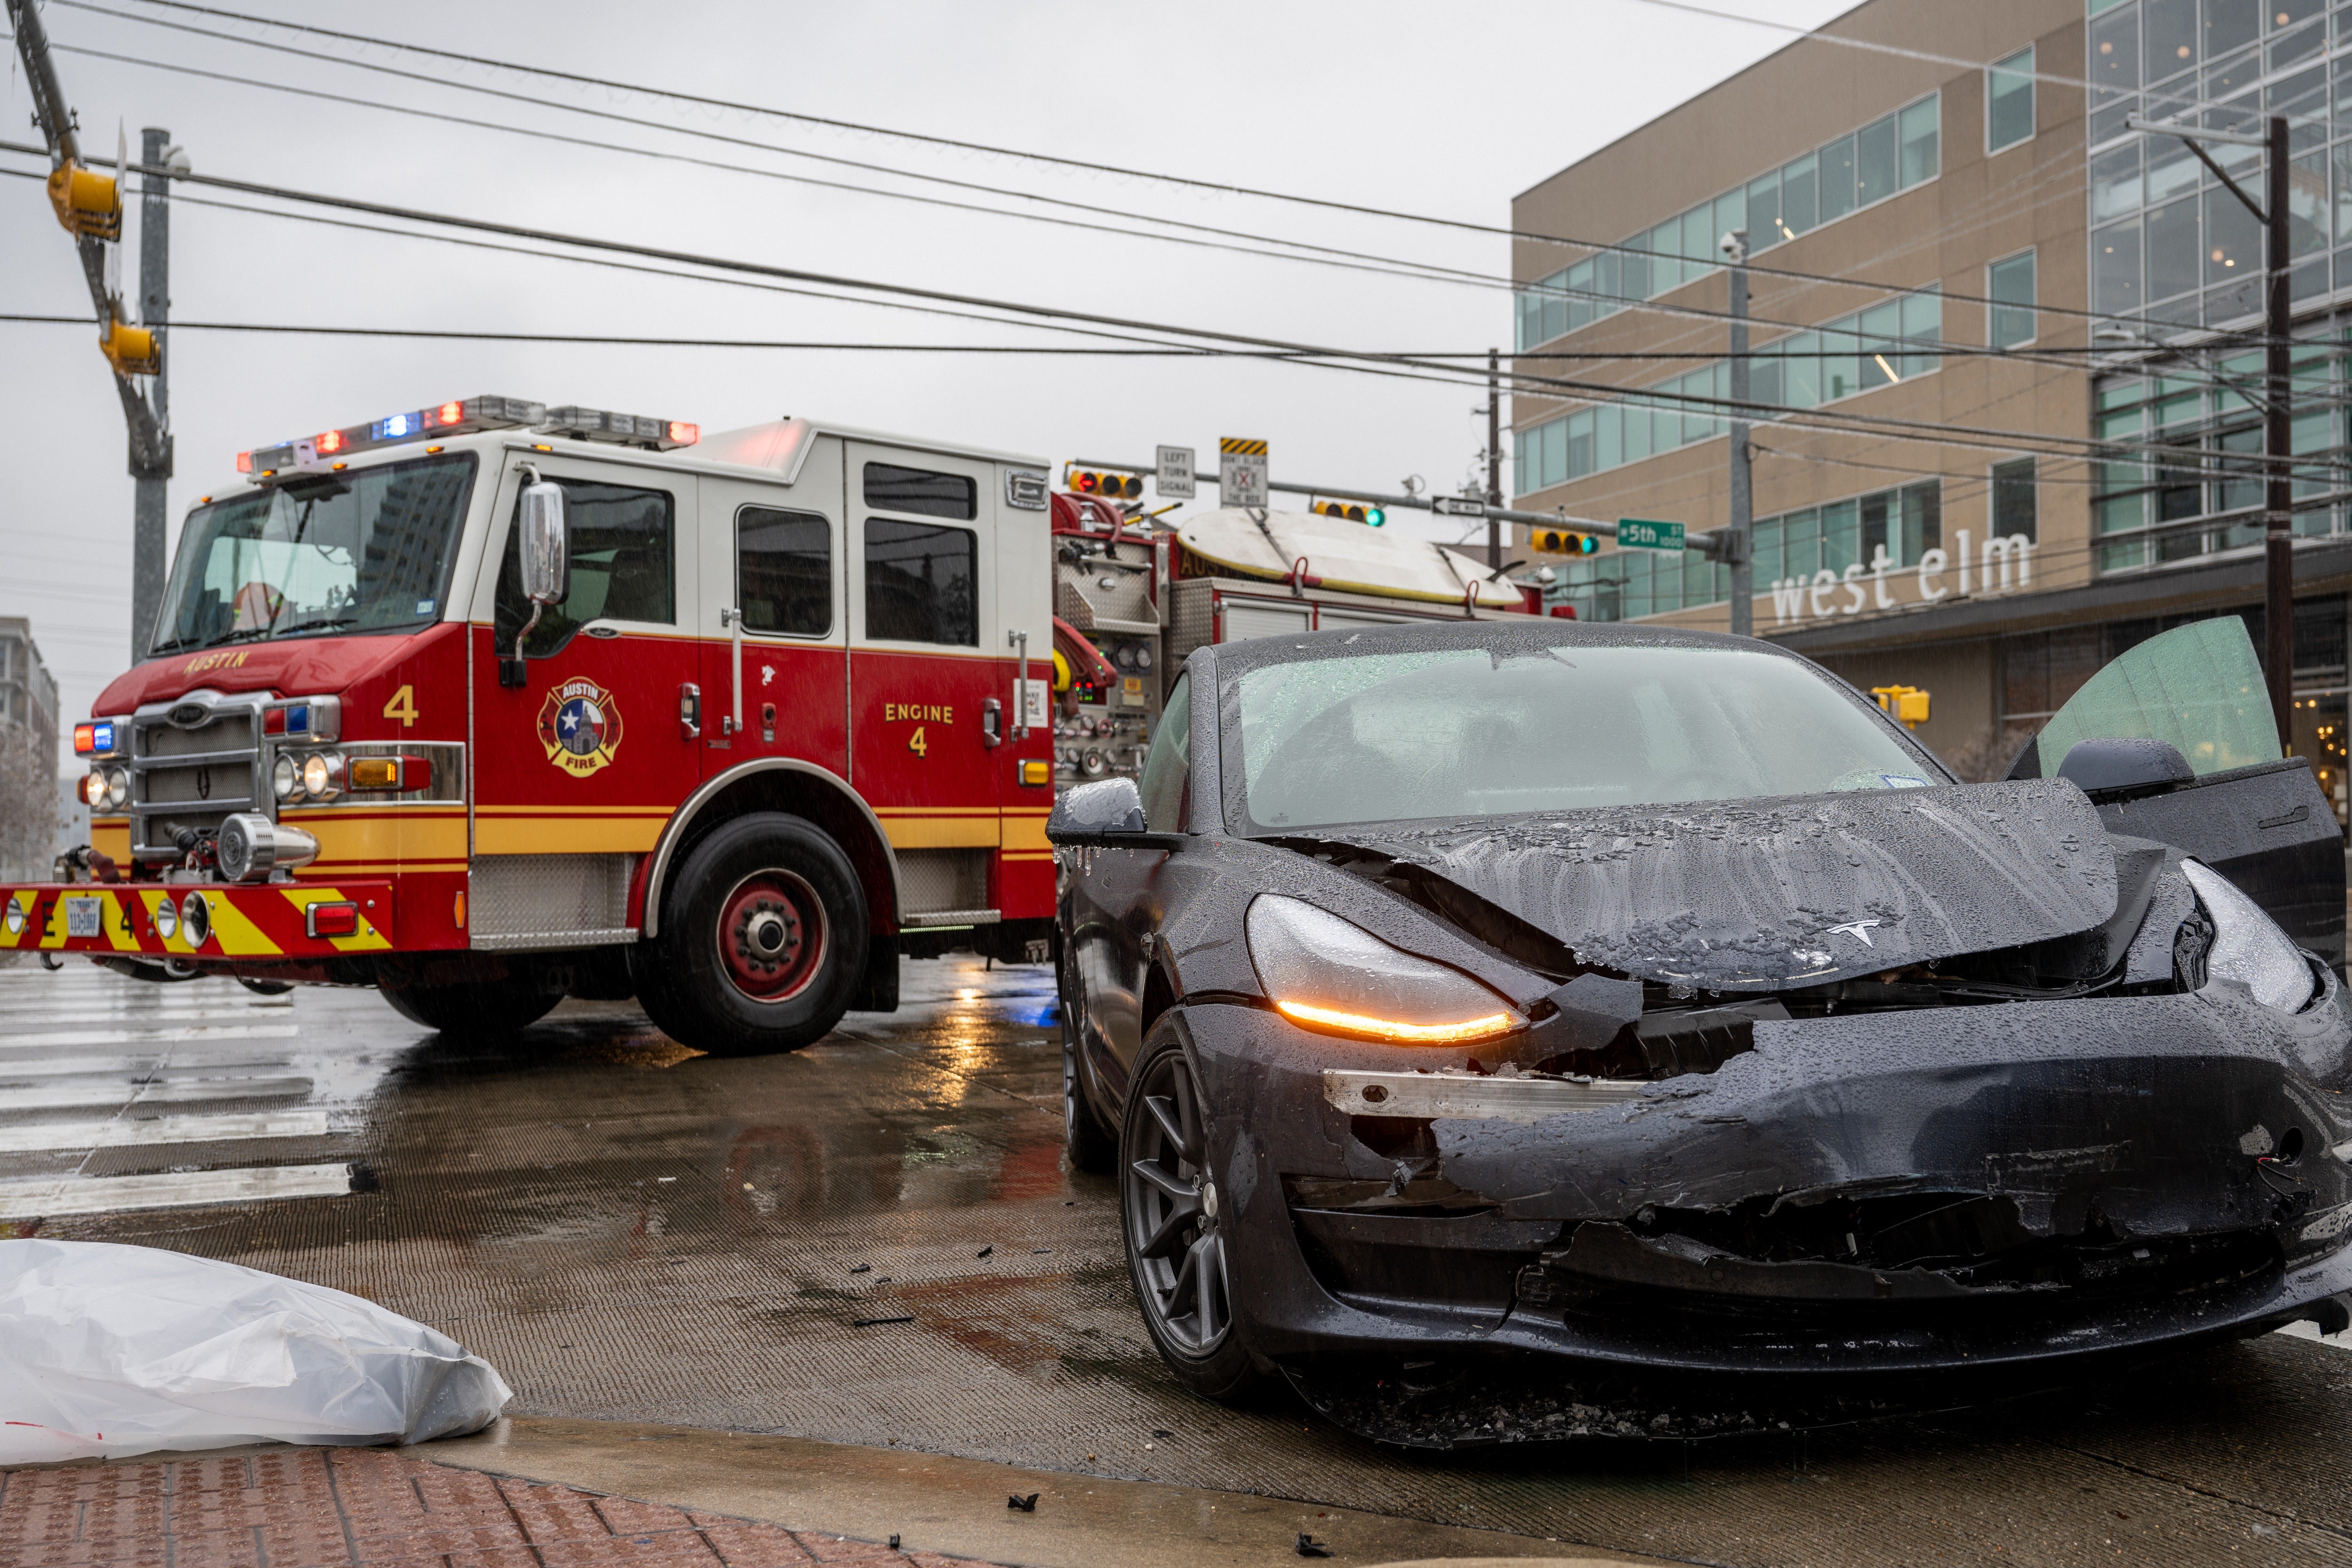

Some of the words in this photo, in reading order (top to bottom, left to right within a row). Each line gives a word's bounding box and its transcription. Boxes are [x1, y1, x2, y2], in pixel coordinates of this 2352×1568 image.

[1164, 452, 1186, 462] LEFT
[1164, 467, 1187, 477] TURN
[1160, 481, 1192, 493] SIGNAL
[1228, 493, 1241, 501] THE
[1628, 524, 1657, 543] 5th
[1772, 543, 1896, 626] west
[1918, 529, 2031, 601] elm
[183, 651, 249, 675] AUSTIN
[563, 683, 598, 700] AUSTIN
[383, 684, 420, 727] 4
[884, 703, 954, 724] ENGINE
[908, 726, 928, 759] 4
[565, 756, 597, 769] FIRE
[43, 902, 55, 936] E
[121, 901, 134, 938] 4
